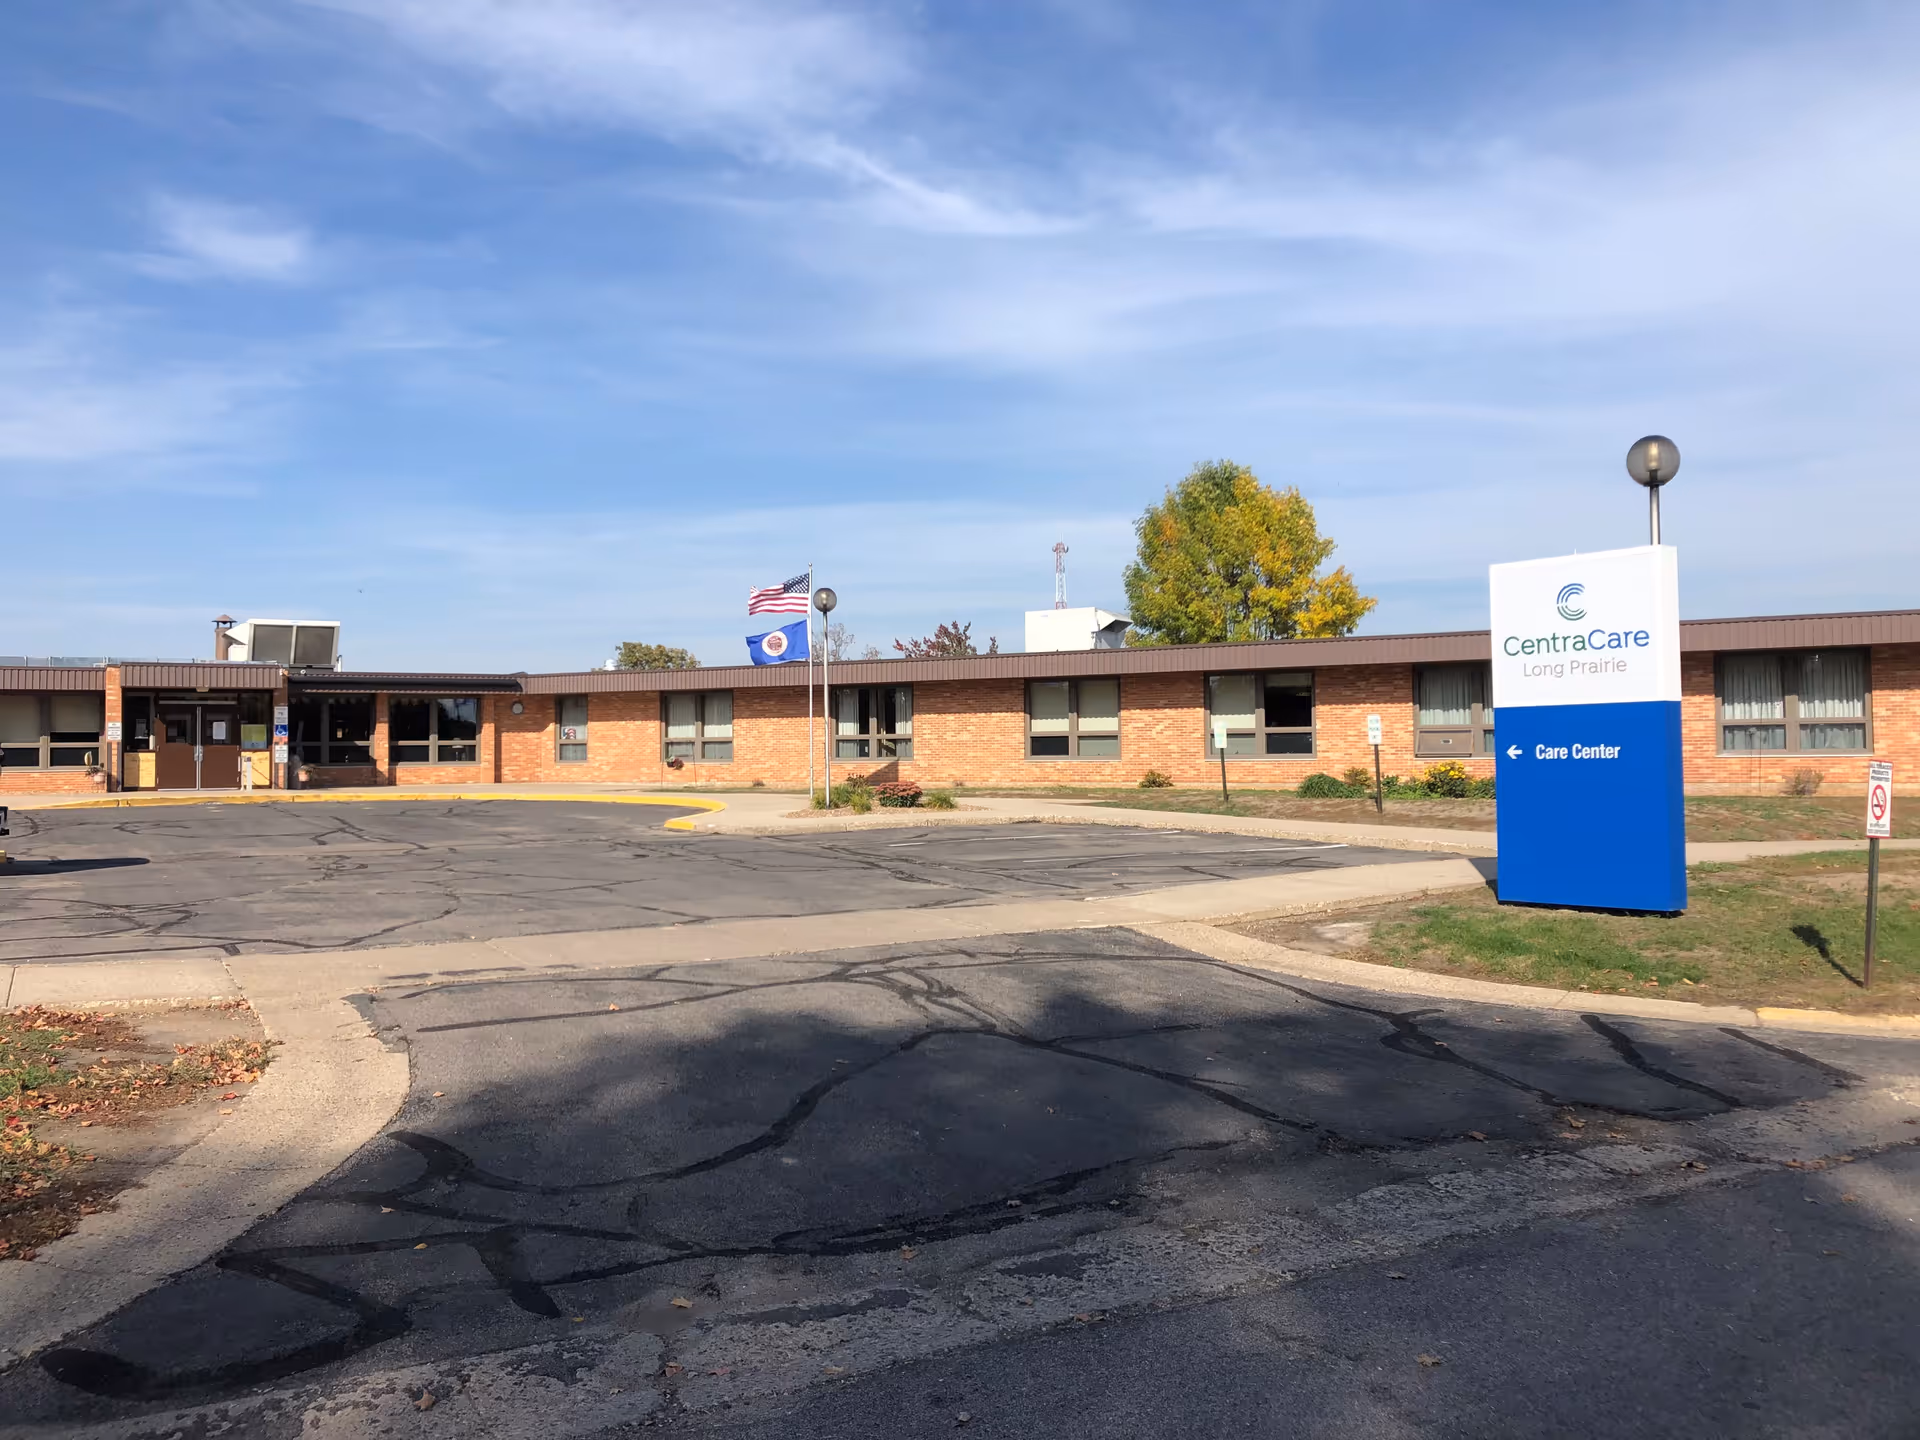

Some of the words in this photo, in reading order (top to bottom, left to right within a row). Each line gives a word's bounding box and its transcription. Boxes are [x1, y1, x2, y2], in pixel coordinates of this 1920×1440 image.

[1504, 629, 1650, 656] CentraCare
[1523, 662, 1564, 678] Long
[1570, 657, 1628, 675] Prairie
[1535, 744, 1568, 759] Care
[1572, 743, 1621, 759] Center
